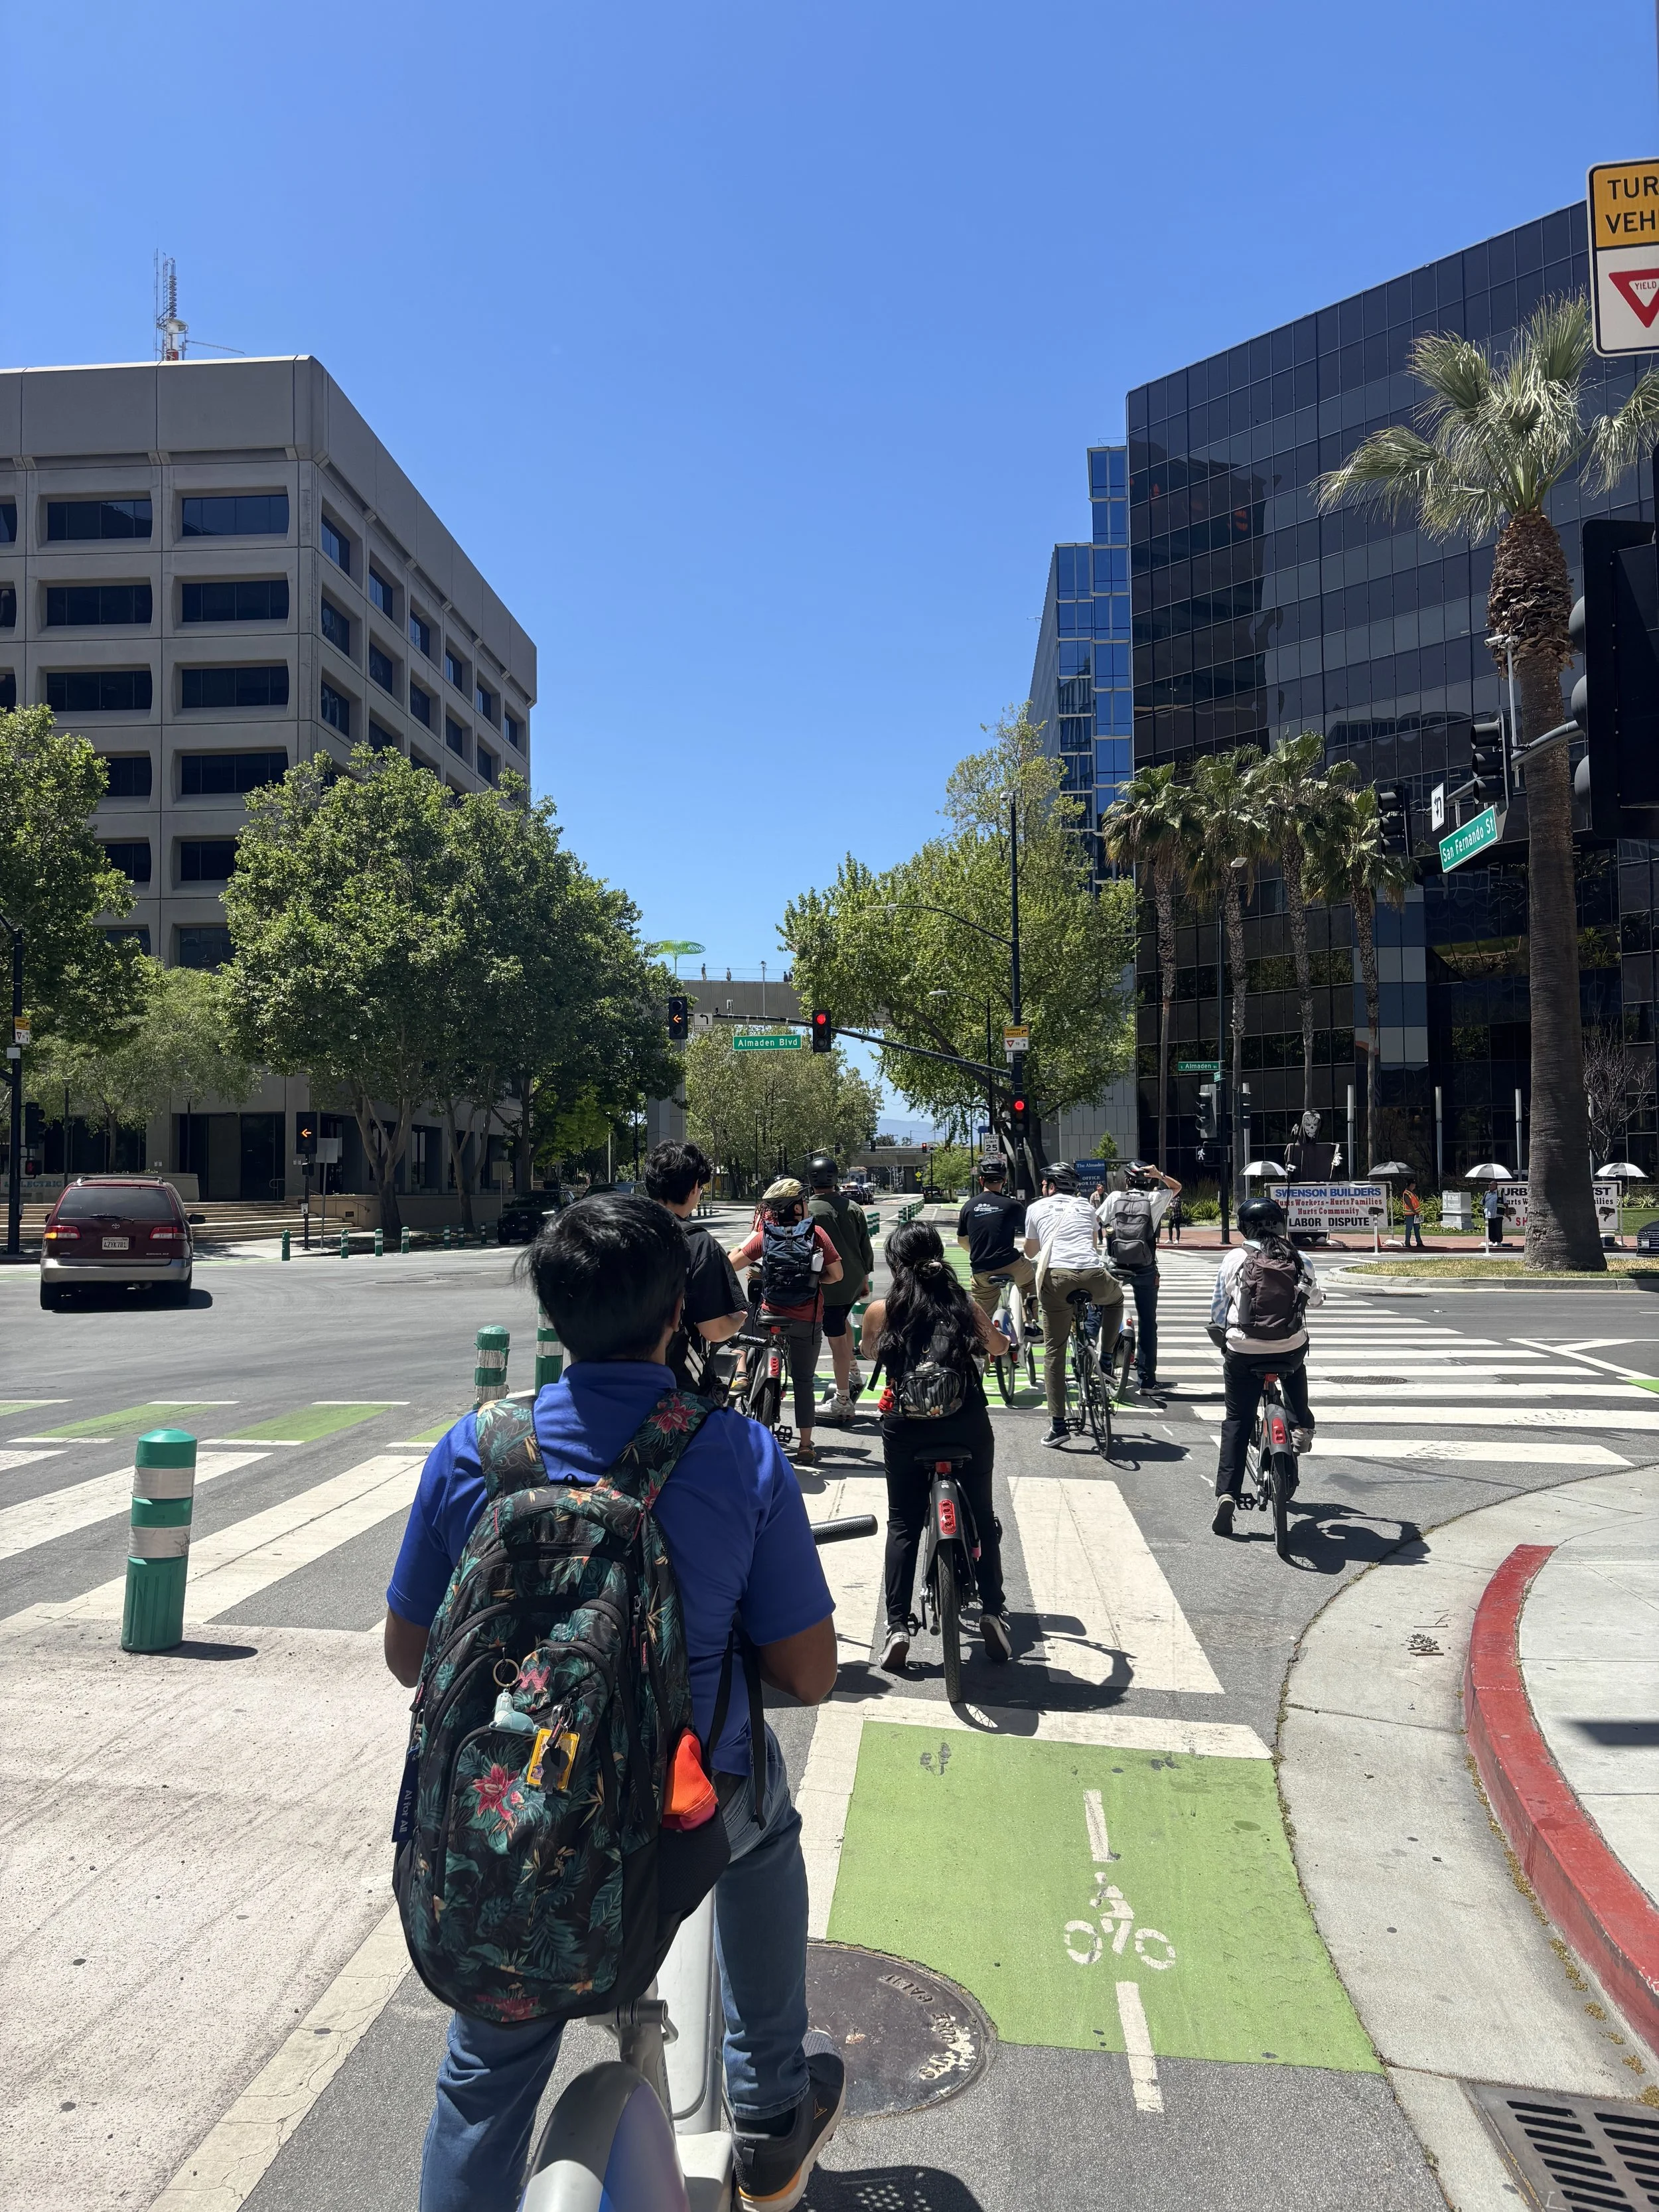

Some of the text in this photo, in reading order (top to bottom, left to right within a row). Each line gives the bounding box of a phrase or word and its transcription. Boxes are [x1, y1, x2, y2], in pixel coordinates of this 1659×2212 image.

[1634, 281, 1657, 290] YIELD
[1442, 816, 1494, 863] San Fernando St
[738, 1039, 775, 1047] Almaden
[1275, 1187, 1382, 1197] SWENSON BUILDERS
[1319, 1207, 1359, 1216] Community
[1289, 1217, 1370, 1227] LABOR DISPUTE
[401, 1802, 411, 1817] for
[399, 1820, 408, 1833] All
